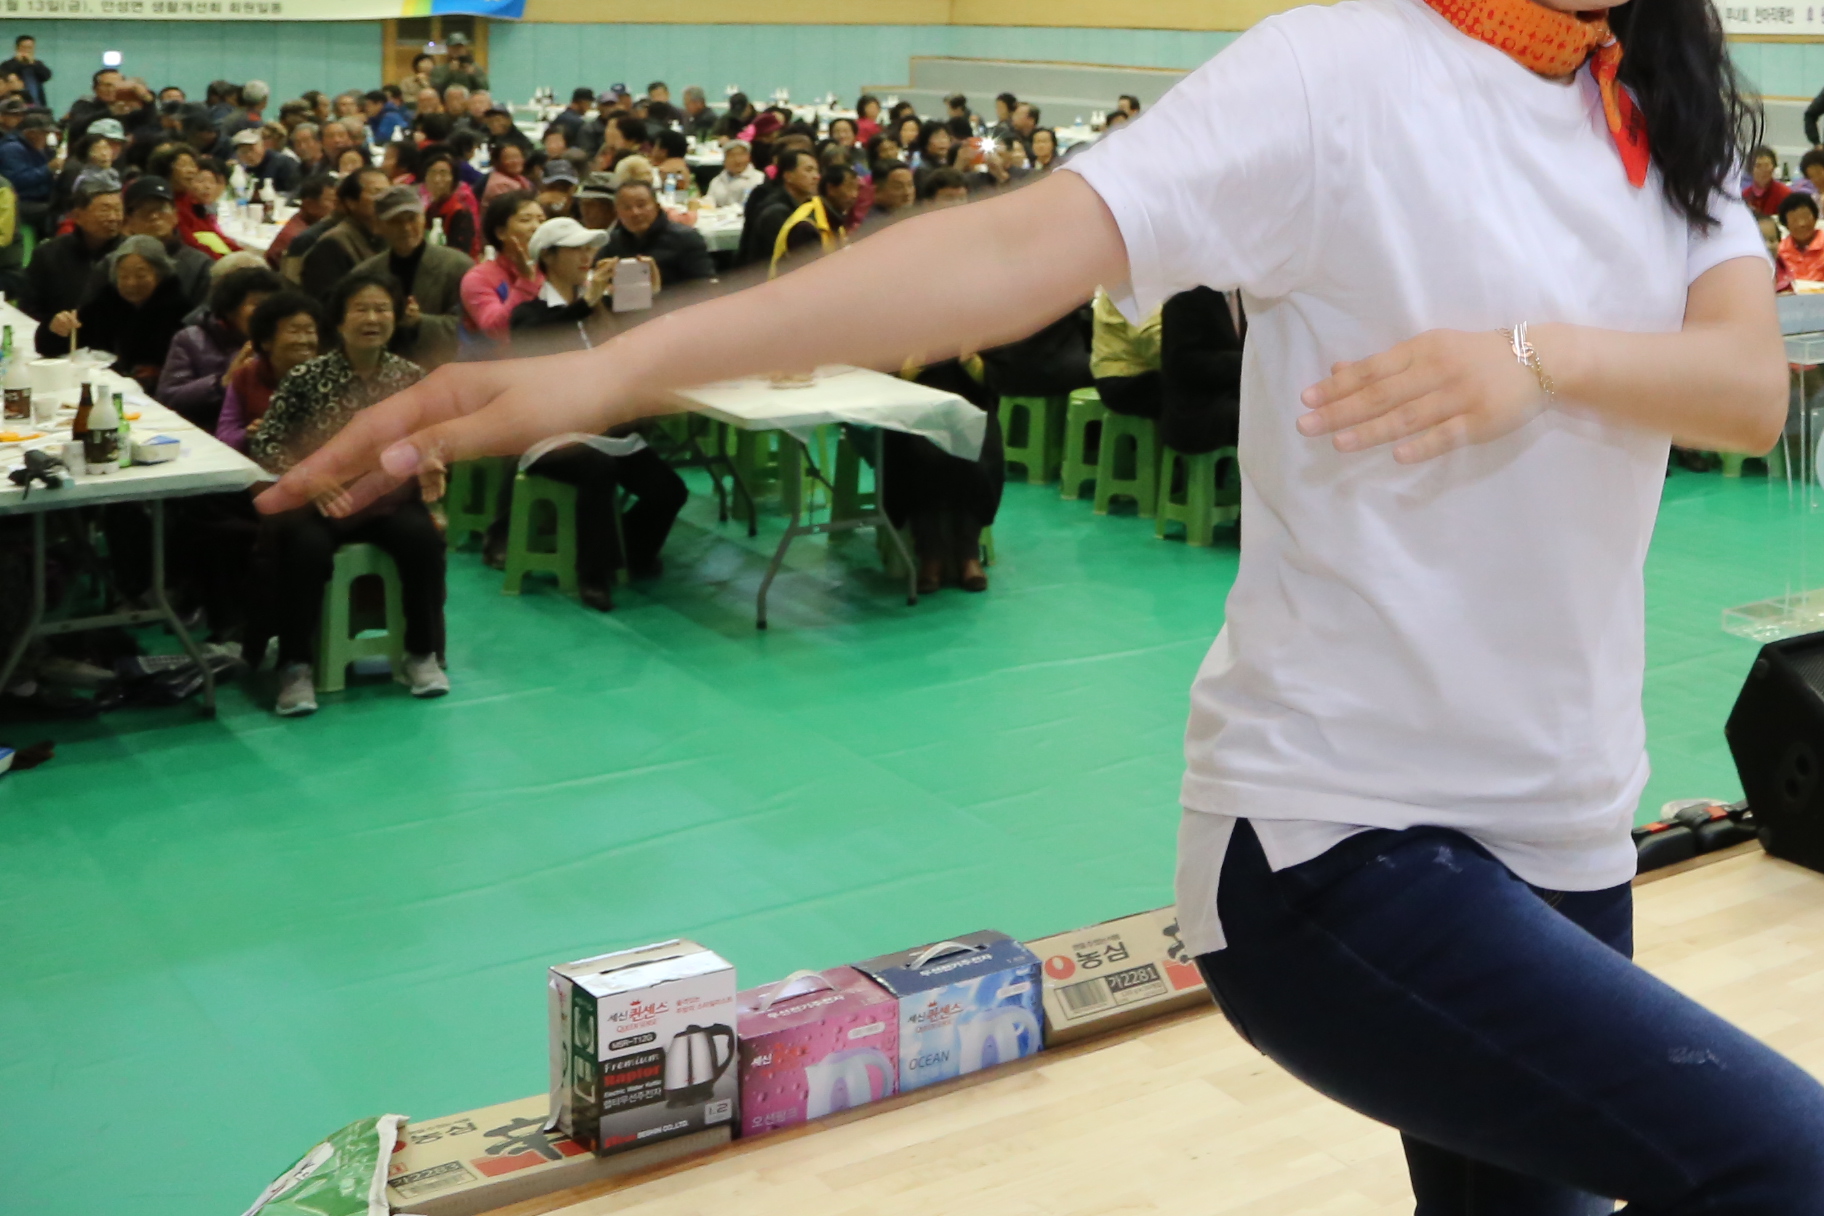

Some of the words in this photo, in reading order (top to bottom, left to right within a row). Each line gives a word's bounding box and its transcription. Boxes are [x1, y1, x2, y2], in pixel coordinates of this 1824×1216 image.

[1076, 941, 1130, 970] 농심
[1108, 967, 1158, 989] 가2281
[607, 1010, 629, 1024] 세신
[628, 1000, 670, 1022] 퀸센스
[908, 1049, 951, 1071] OCEAN
